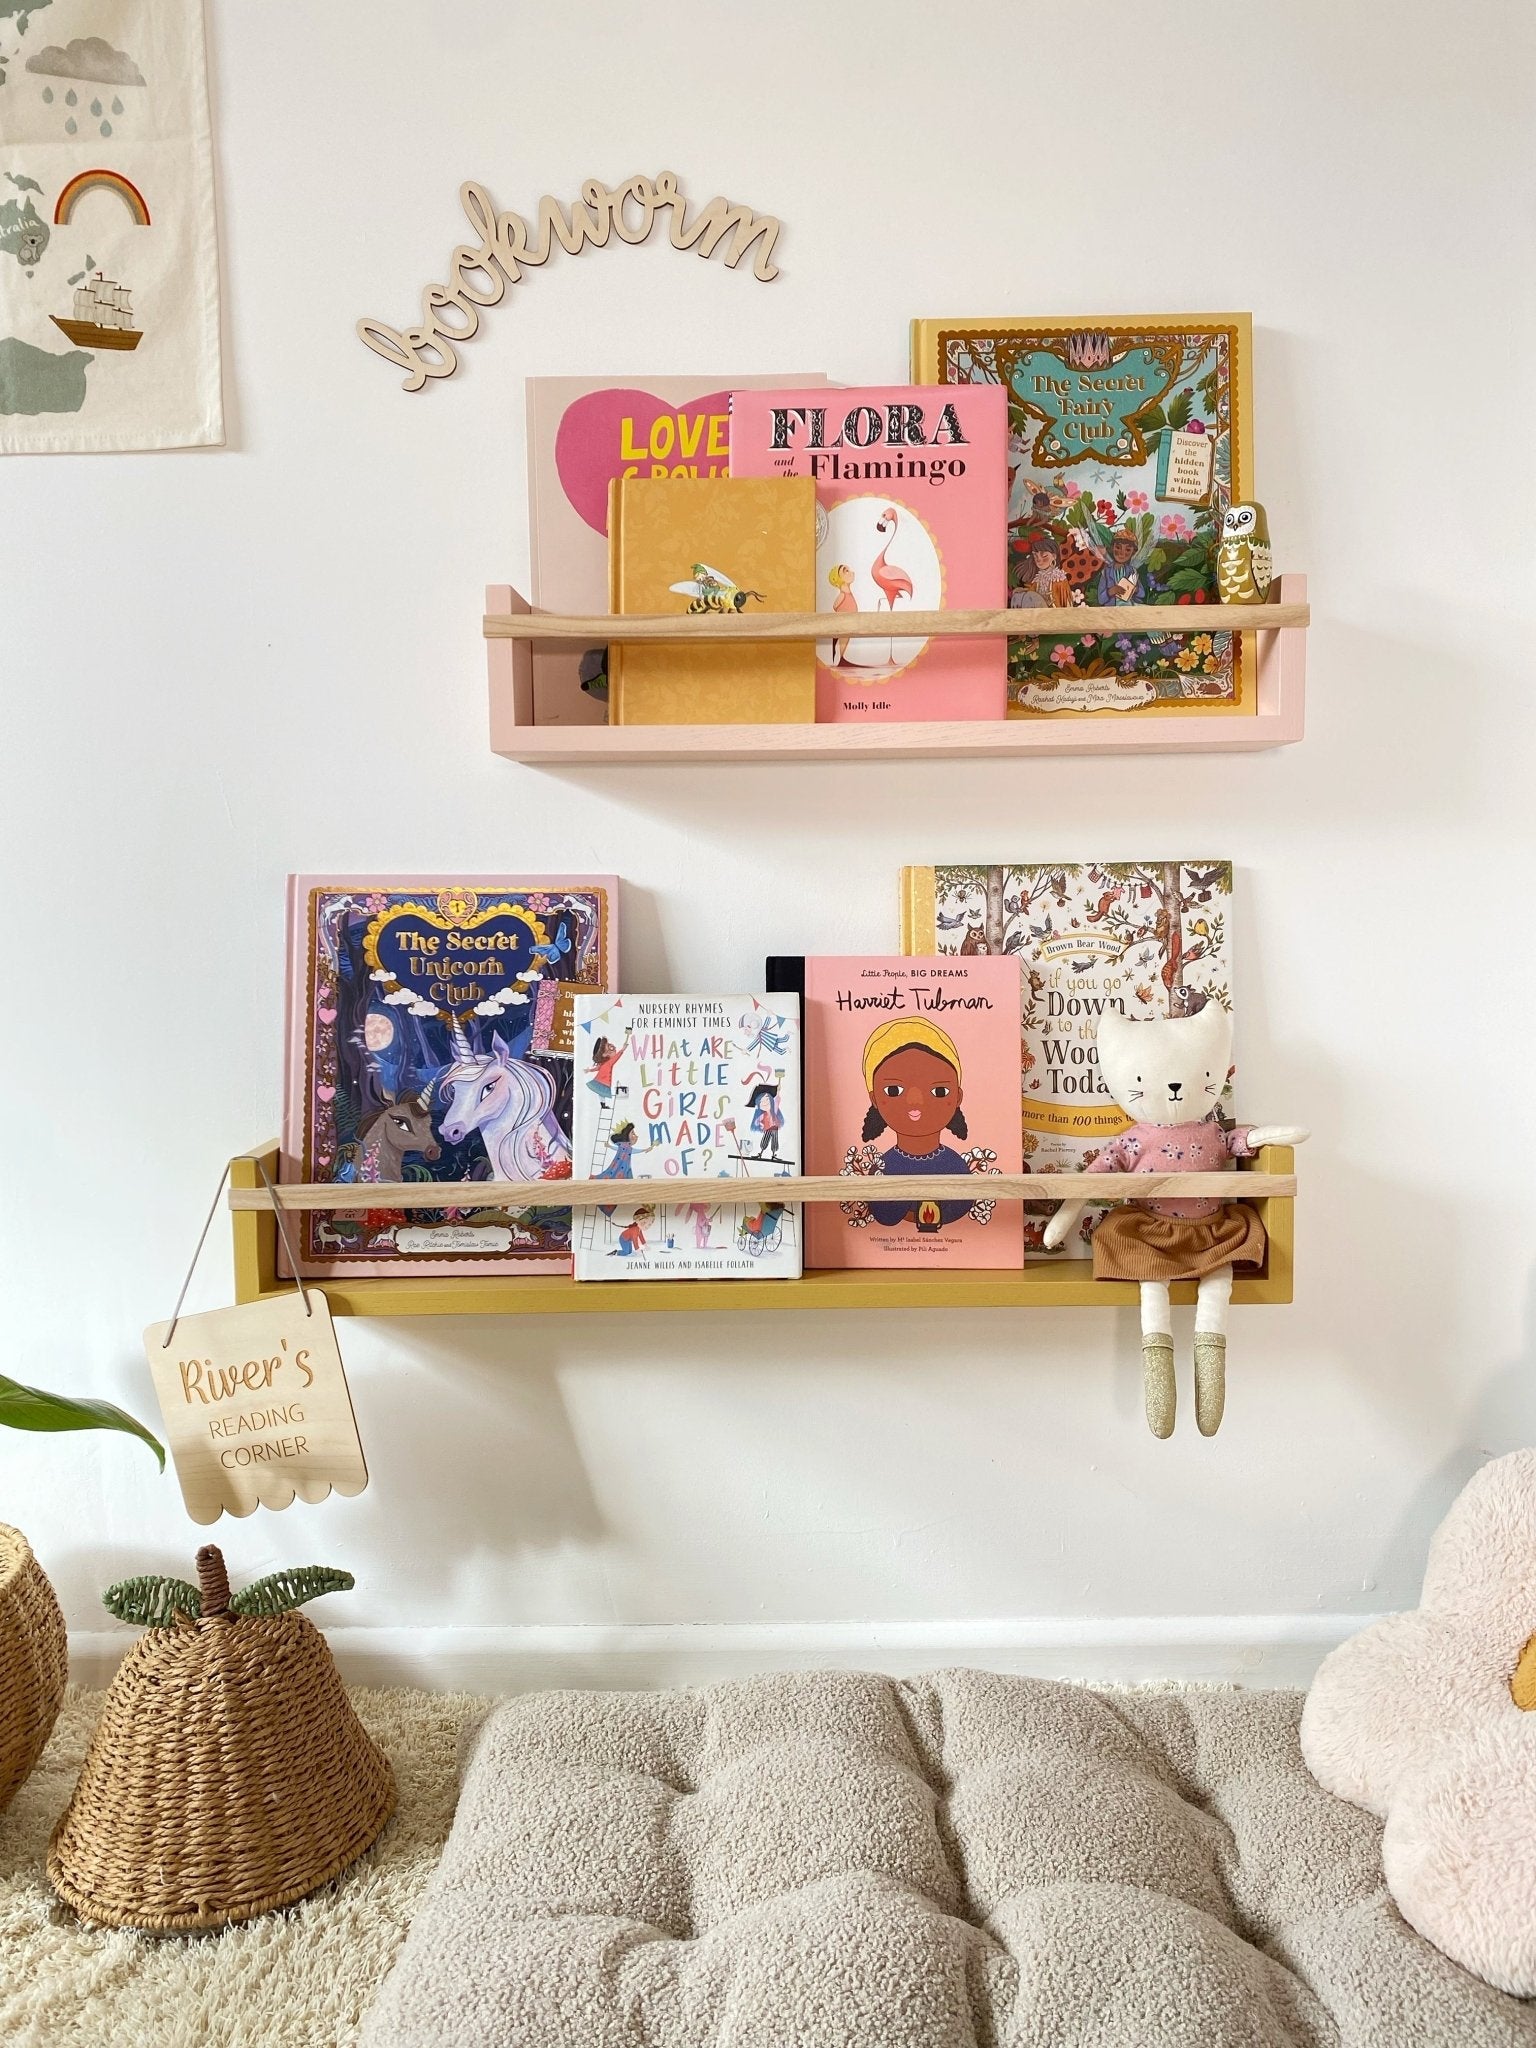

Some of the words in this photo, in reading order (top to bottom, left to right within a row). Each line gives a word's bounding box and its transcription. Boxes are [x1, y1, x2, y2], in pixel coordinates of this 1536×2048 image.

[0, 216, 40, 238] tralia
[356, 171, 779, 391] bookworm
[1030, 375, 1072, 398] The
[1078, 374, 1145, 392] Secret
[1057, 398, 1115, 420] Fairy
[620, 414, 729, 460] LOVE
[767, 403, 971, 450] FLORA
[1063, 421, 1115, 444] Club
[1176, 437, 1208, 448] Discover
[774, 456, 794, 466] and
[809, 453, 966, 486] Flamingo
[1174, 457, 1204, 467] hidden
[1177, 467, 1199, 476] book
[783, 469, 798, 477] the
[1174, 477, 1201, 486] within
[1177, 486, 1202, 495] book!
[843, 702, 869, 712] Molly
[872, 702, 891, 710] Idle
[395, 931, 440, 956] The
[445, 931, 520, 951] Secret
[1046, 942, 1073, 954] Brown
[1077, 940, 1095, 948] Bear
[1098, 940, 1121, 953] Wood
[409, 956, 506, 980] Unicorn
[883, 969, 908, 979] People,
[1049, 967, 1062, 988] if
[1066, 979, 1097, 997] you
[1104, 978, 1121, 997] go
[429, 982, 485, 1006] Club
[836, 986, 905, 1011] Harriet
[909, 987, 993, 1011] Tubman
[1047, 991, 1126, 1016] Down
[639, 1003, 680, 1015] NURSERY
[686, 1003, 723, 1014] RHYMES
[631, 1018, 648, 1028] FOR
[653, 1017, 697, 1028] FEMINIST
[703, 1017, 731, 1028] TIMES
[1058, 1018, 1072, 1032] to
[1079, 1019, 1097, 1040] th
[700, 1036, 734, 1059] ARE
[1041, 1040, 1100, 1065] Woo
[1047, 1069, 1111, 1095] Toda
[1048, 1113, 1069, 1124] than
[1072, 1116, 1092, 1126] 100
[1094, 1115, 1122, 1125] things
[627, 1261, 650, 1270] JEANNE
[655, 1261, 675, 1269] WILLIS
[678, 1261, 692, 1269] AND
[695, 1261, 723, 1269] ISABELLE
[727, 1260, 754, 1269] FOLLATH
[179, 1339, 314, 1404] River's
[209, 1403, 305, 1439] READING
[221, 1436, 309, 1468] CORNER
